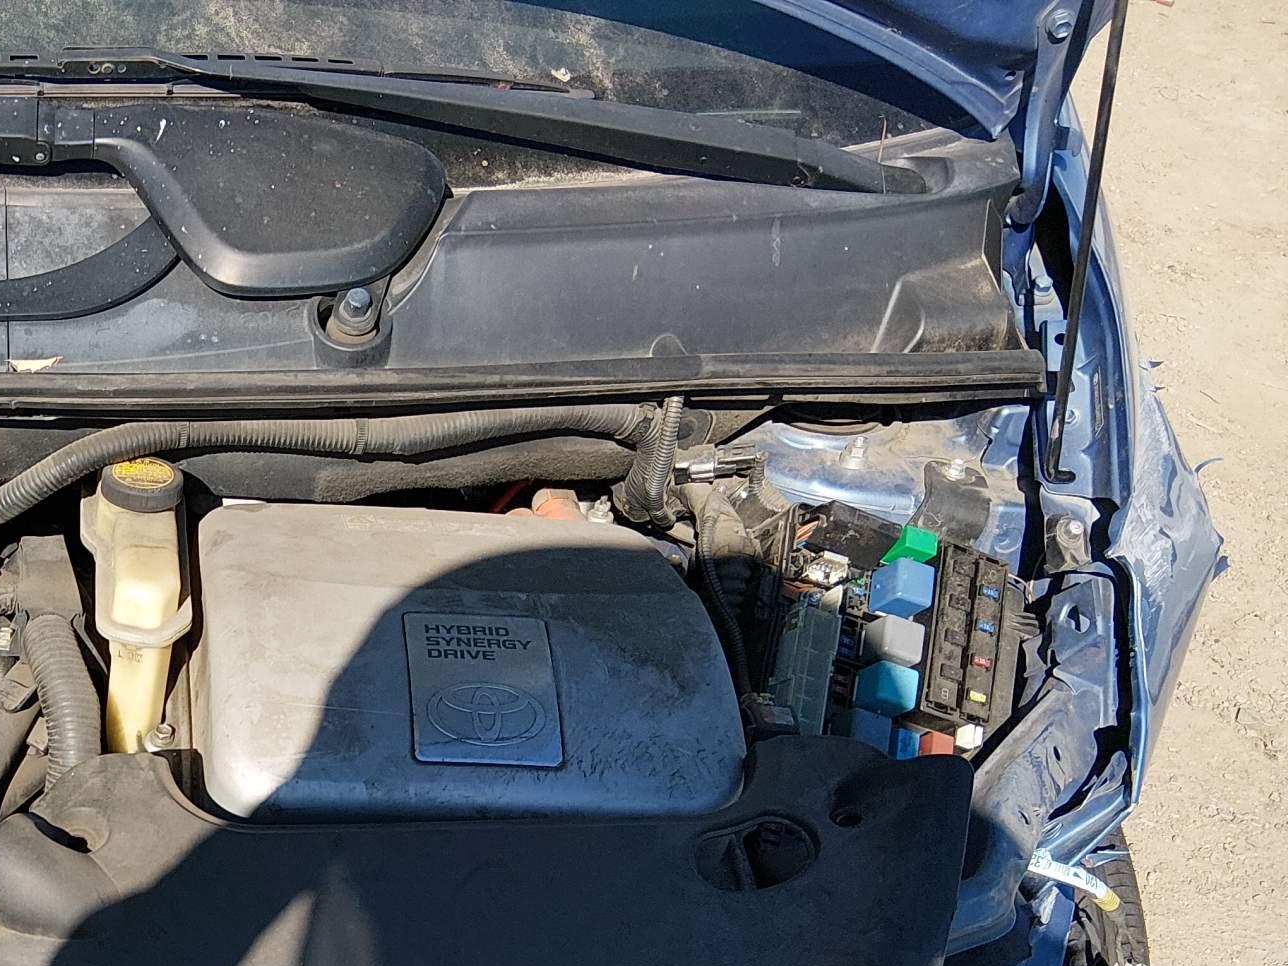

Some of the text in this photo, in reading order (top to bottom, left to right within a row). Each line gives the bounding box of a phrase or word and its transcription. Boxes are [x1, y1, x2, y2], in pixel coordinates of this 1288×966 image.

[424, 623, 509, 638] HYBRID
[425, 636, 532, 651] SYNERGY
[427, 649, 496, 661] DRIVE
